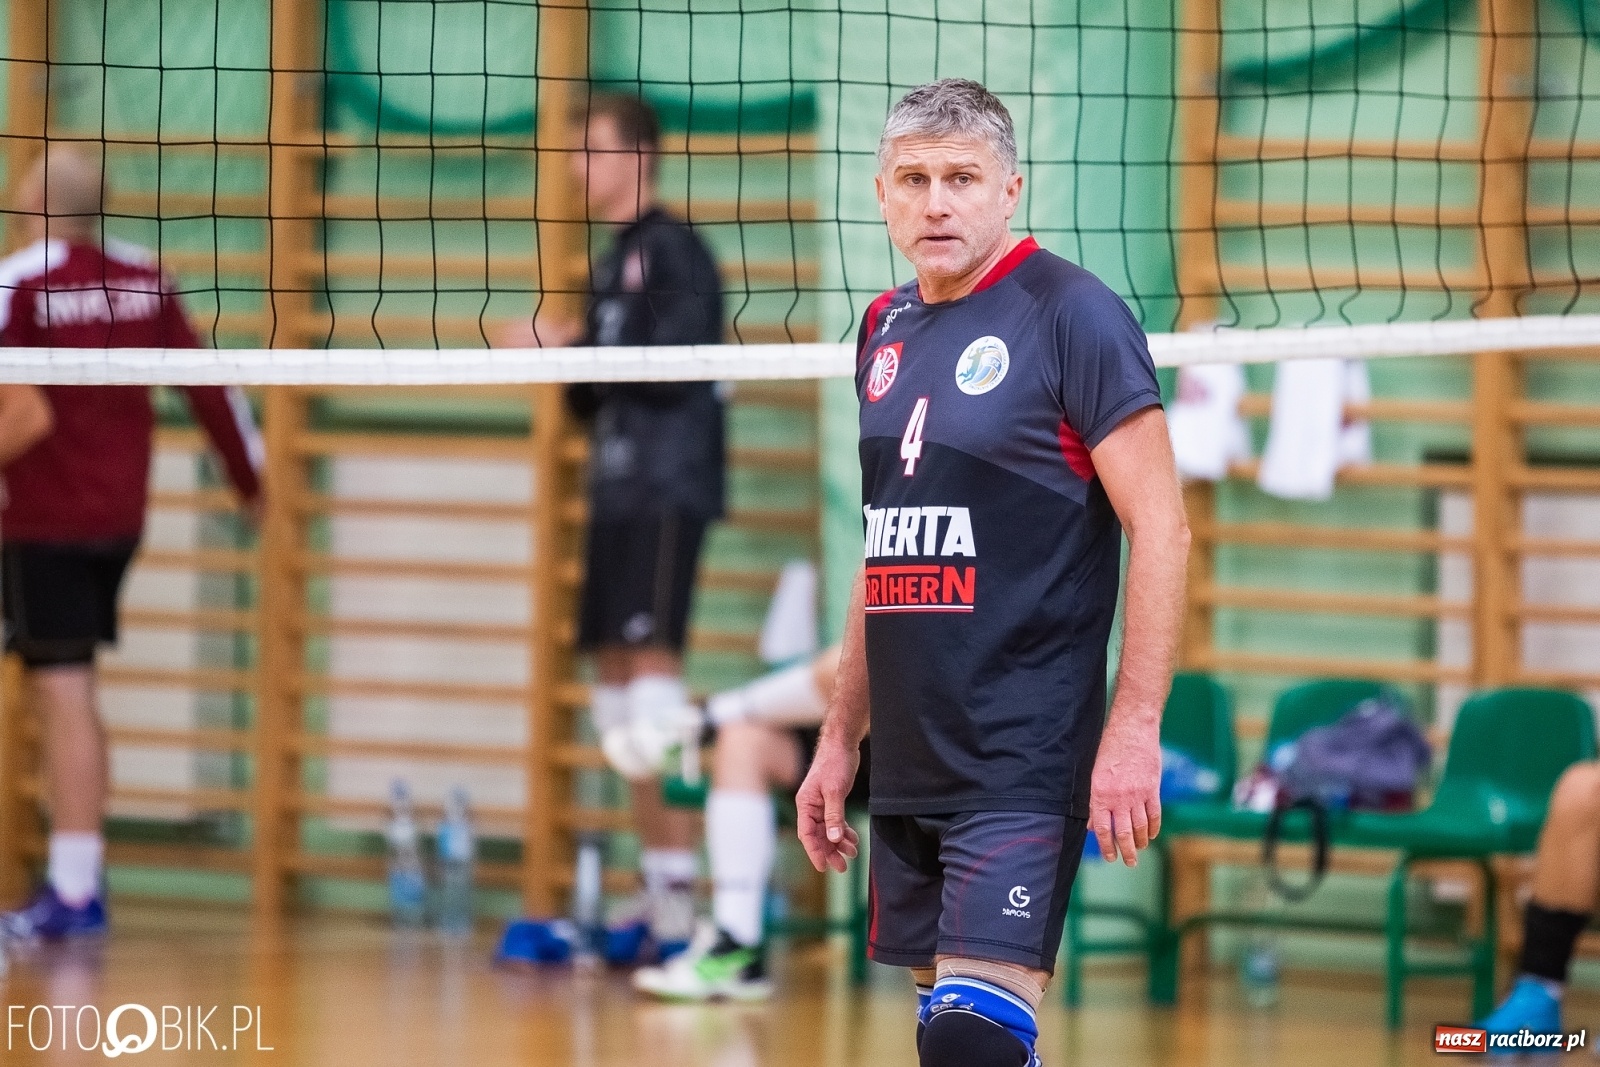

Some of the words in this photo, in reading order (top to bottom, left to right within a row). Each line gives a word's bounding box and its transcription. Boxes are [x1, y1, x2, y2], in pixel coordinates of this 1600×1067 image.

[900, 397, 929, 477] 4
[863, 503, 977, 558] MERTA
[865, 565, 976, 605] ORTHERN
